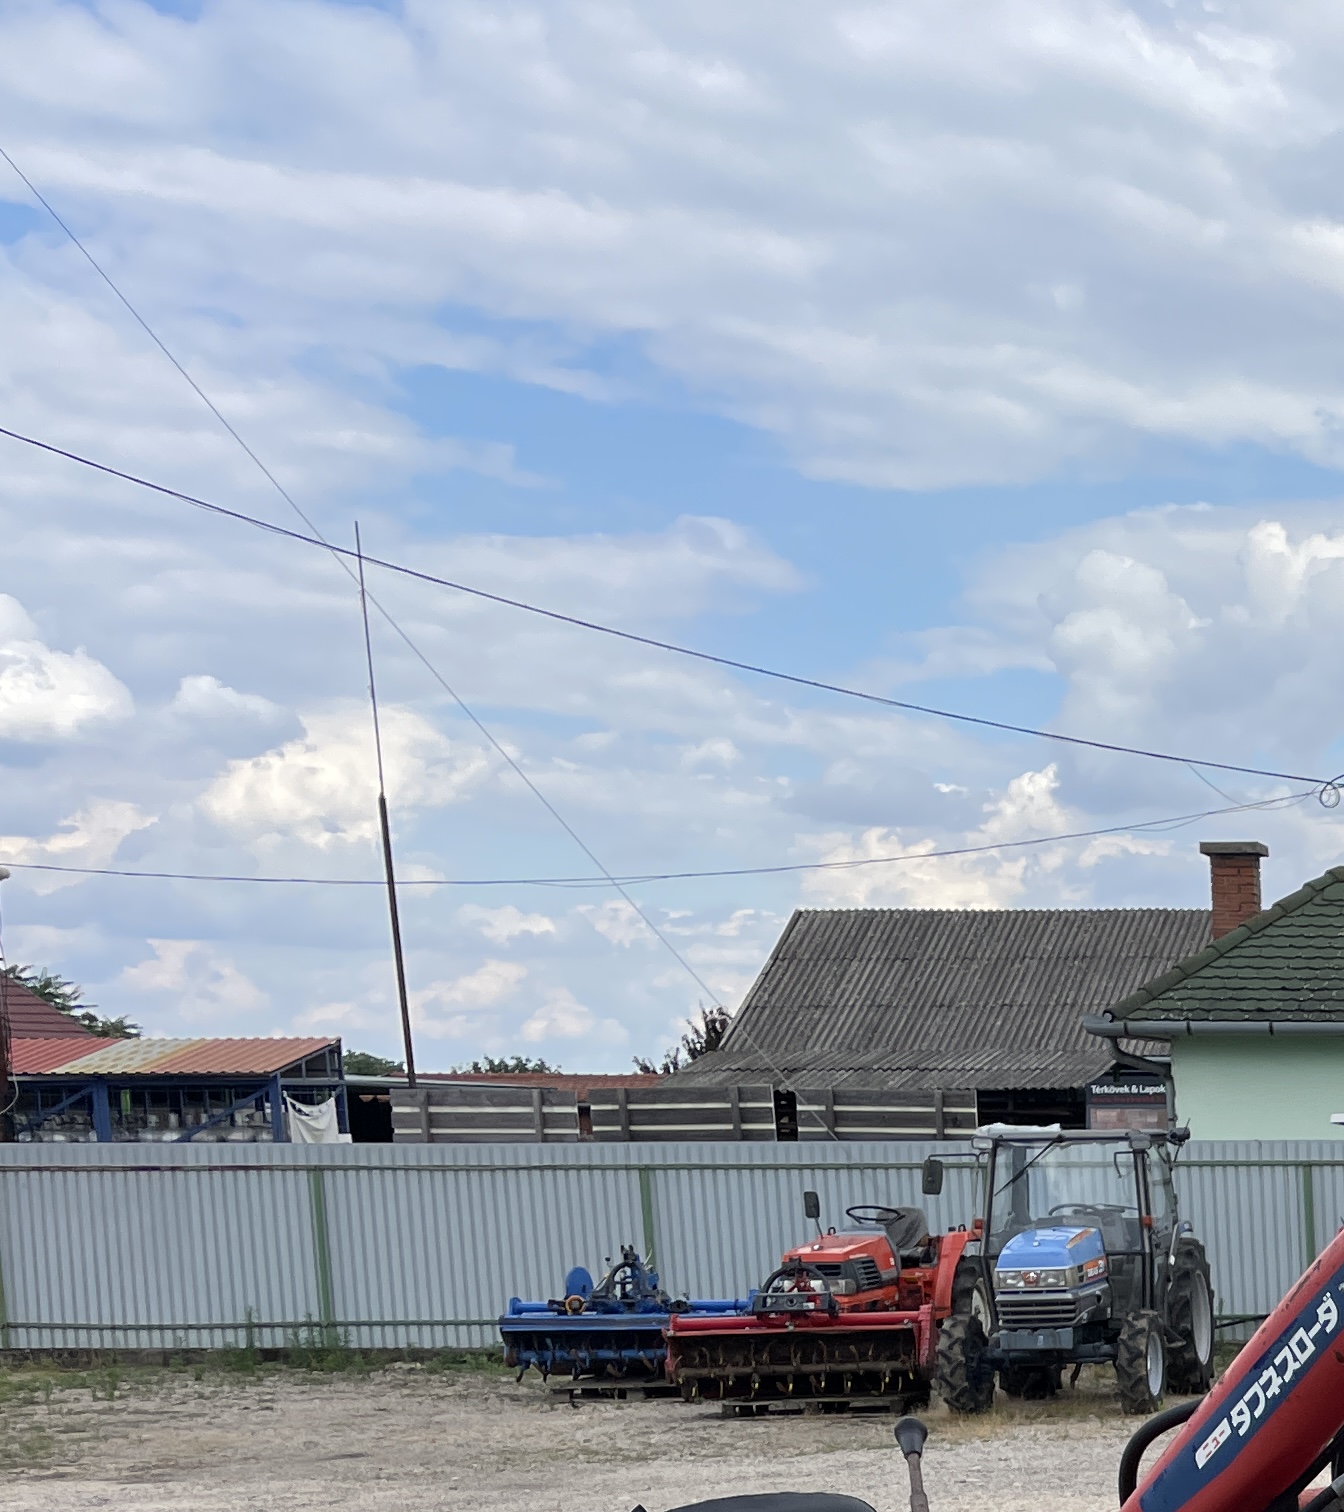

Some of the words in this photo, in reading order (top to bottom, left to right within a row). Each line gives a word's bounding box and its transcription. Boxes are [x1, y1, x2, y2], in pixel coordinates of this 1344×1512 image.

[1091, 1084, 1130, 1094] Térkövek
[1131, 1085, 1138, 1093] &
[1139, 1084, 1166, 1095] Lapok
